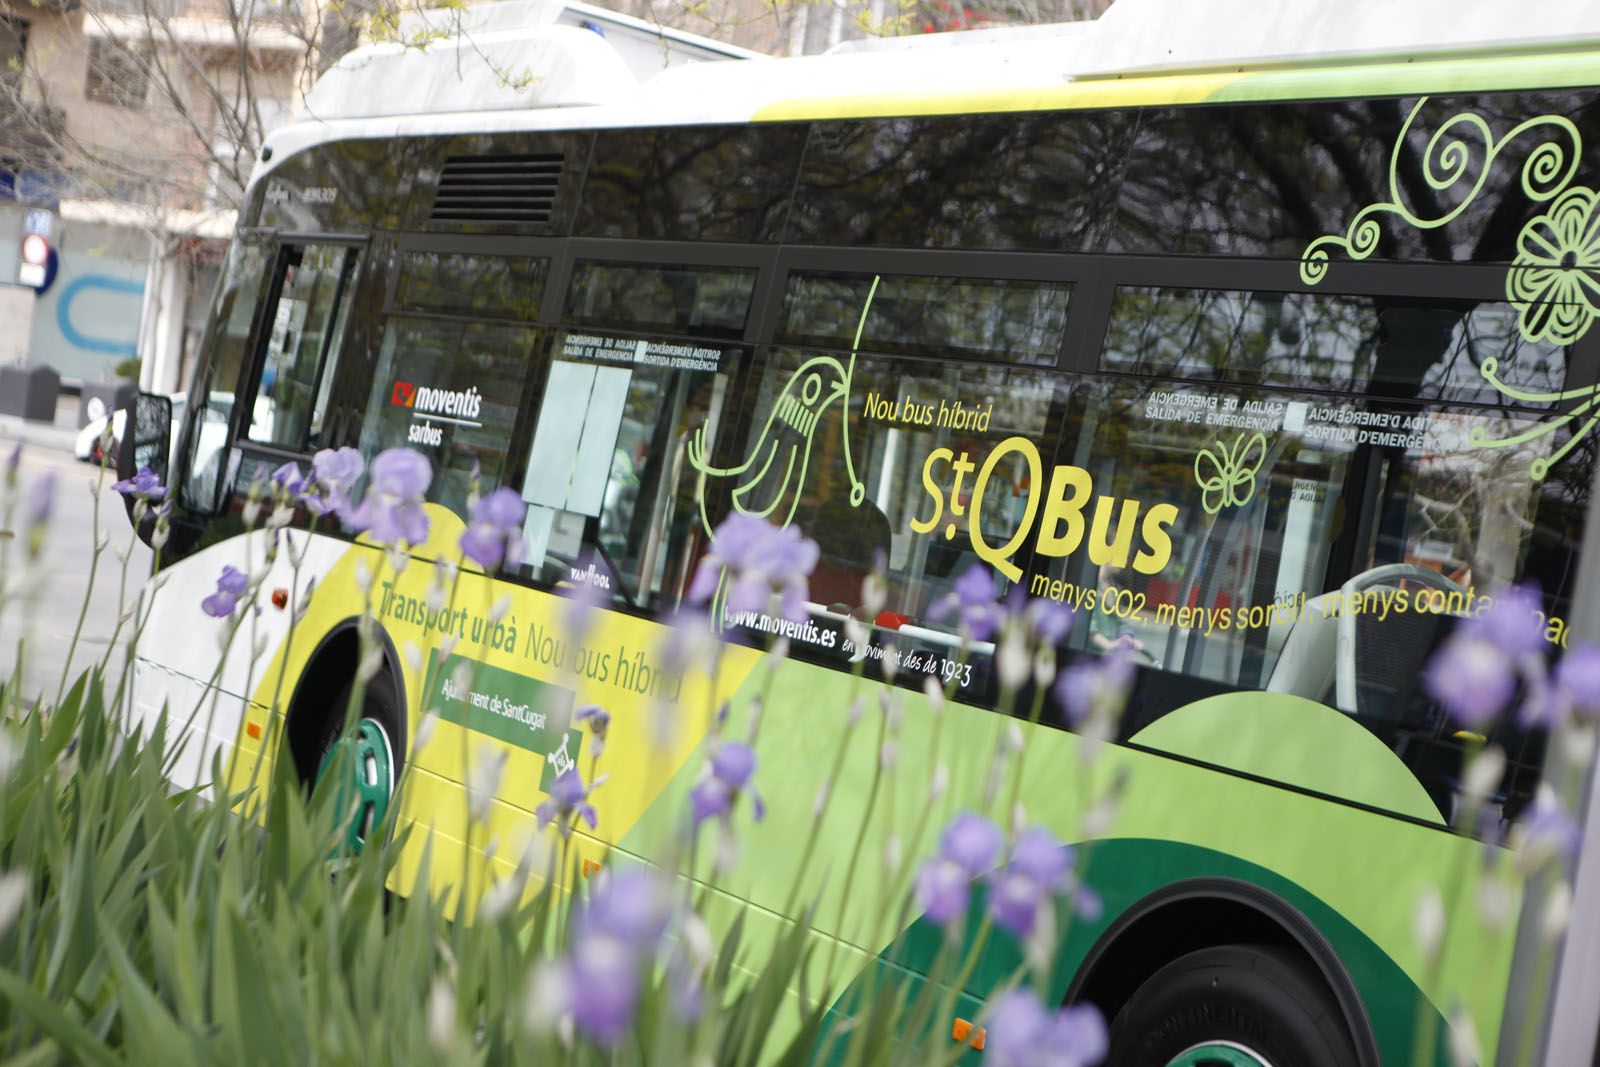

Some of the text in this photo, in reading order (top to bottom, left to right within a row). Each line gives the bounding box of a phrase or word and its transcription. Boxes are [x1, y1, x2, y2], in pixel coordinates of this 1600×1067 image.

[563, 345, 633, 361] SALIDA DE EMERGENCIA
[643, 355, 670, 367] SORTIDA
[414, 386, 483, 418] moventis
[863, 391, 994, 433] Nou bus híbrid
[408, 420, 443, 447] sarbus
[1144, 406, 1279, 432] SALIDA DE EMERGENCIA
[1304, 424, 1358, 443] SORTIDA
[1030, 573, 1097, 613] menys
[1100, 586, 1148, 625] CO2,
[1155, 602, 1232, 637] menys
[1322, 588, 1410, 622] menys
[380, 580, 468, 640] Transport
[471, 612, 517, 654] urbà
[524, 621, 567, 669] Nou
[613, 645, 685, 704] híbr
[842, 638, 854, 653] en
[857, 641, 903, 666] ovimt
[902, 649, 923, 671] des
[922, 659, 937, 675] de
[939, 662, 972, 687] 1923
[441, 678, 490, 710] Ajument
[489, 693, 503, 715] de
